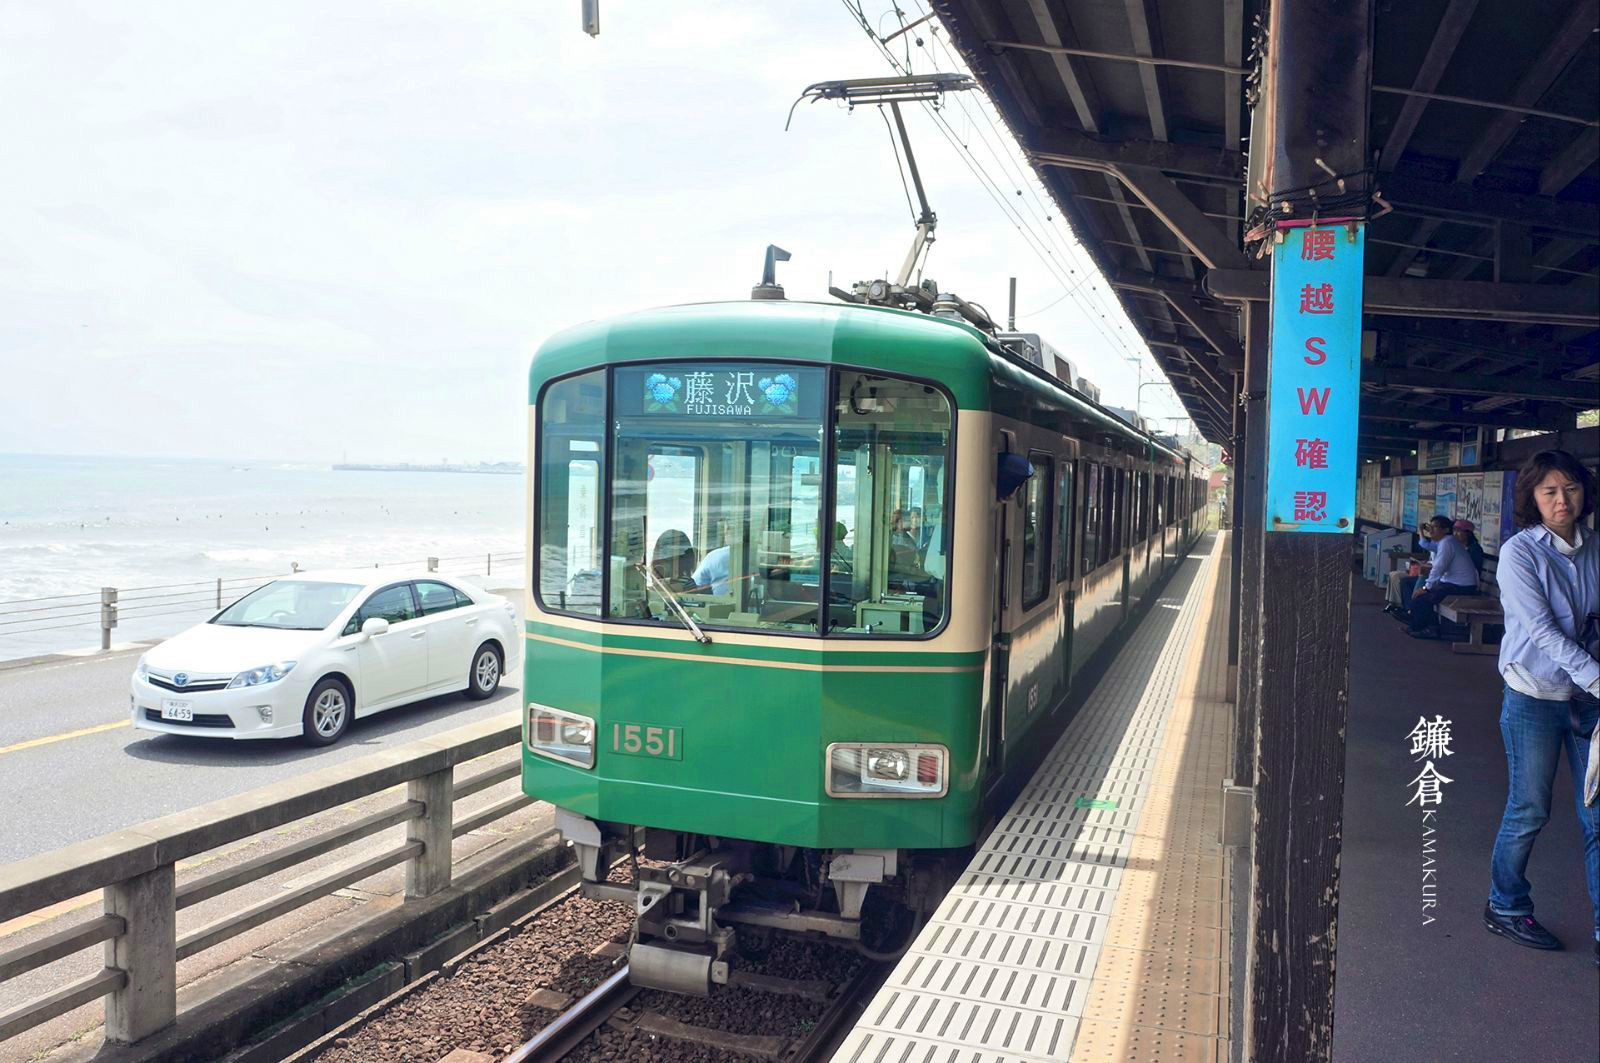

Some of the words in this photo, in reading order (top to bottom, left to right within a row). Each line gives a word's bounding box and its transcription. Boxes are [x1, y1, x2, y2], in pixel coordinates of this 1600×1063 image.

[684, 371, 755, 404] 藤沢
[1293, 229, 1336, 521] 腰越SW確認
[687, 404, 752, 415] FUJISAWA
[168, 708, 191, 719] 64-59
[613, 723, 674, 757] 1551
